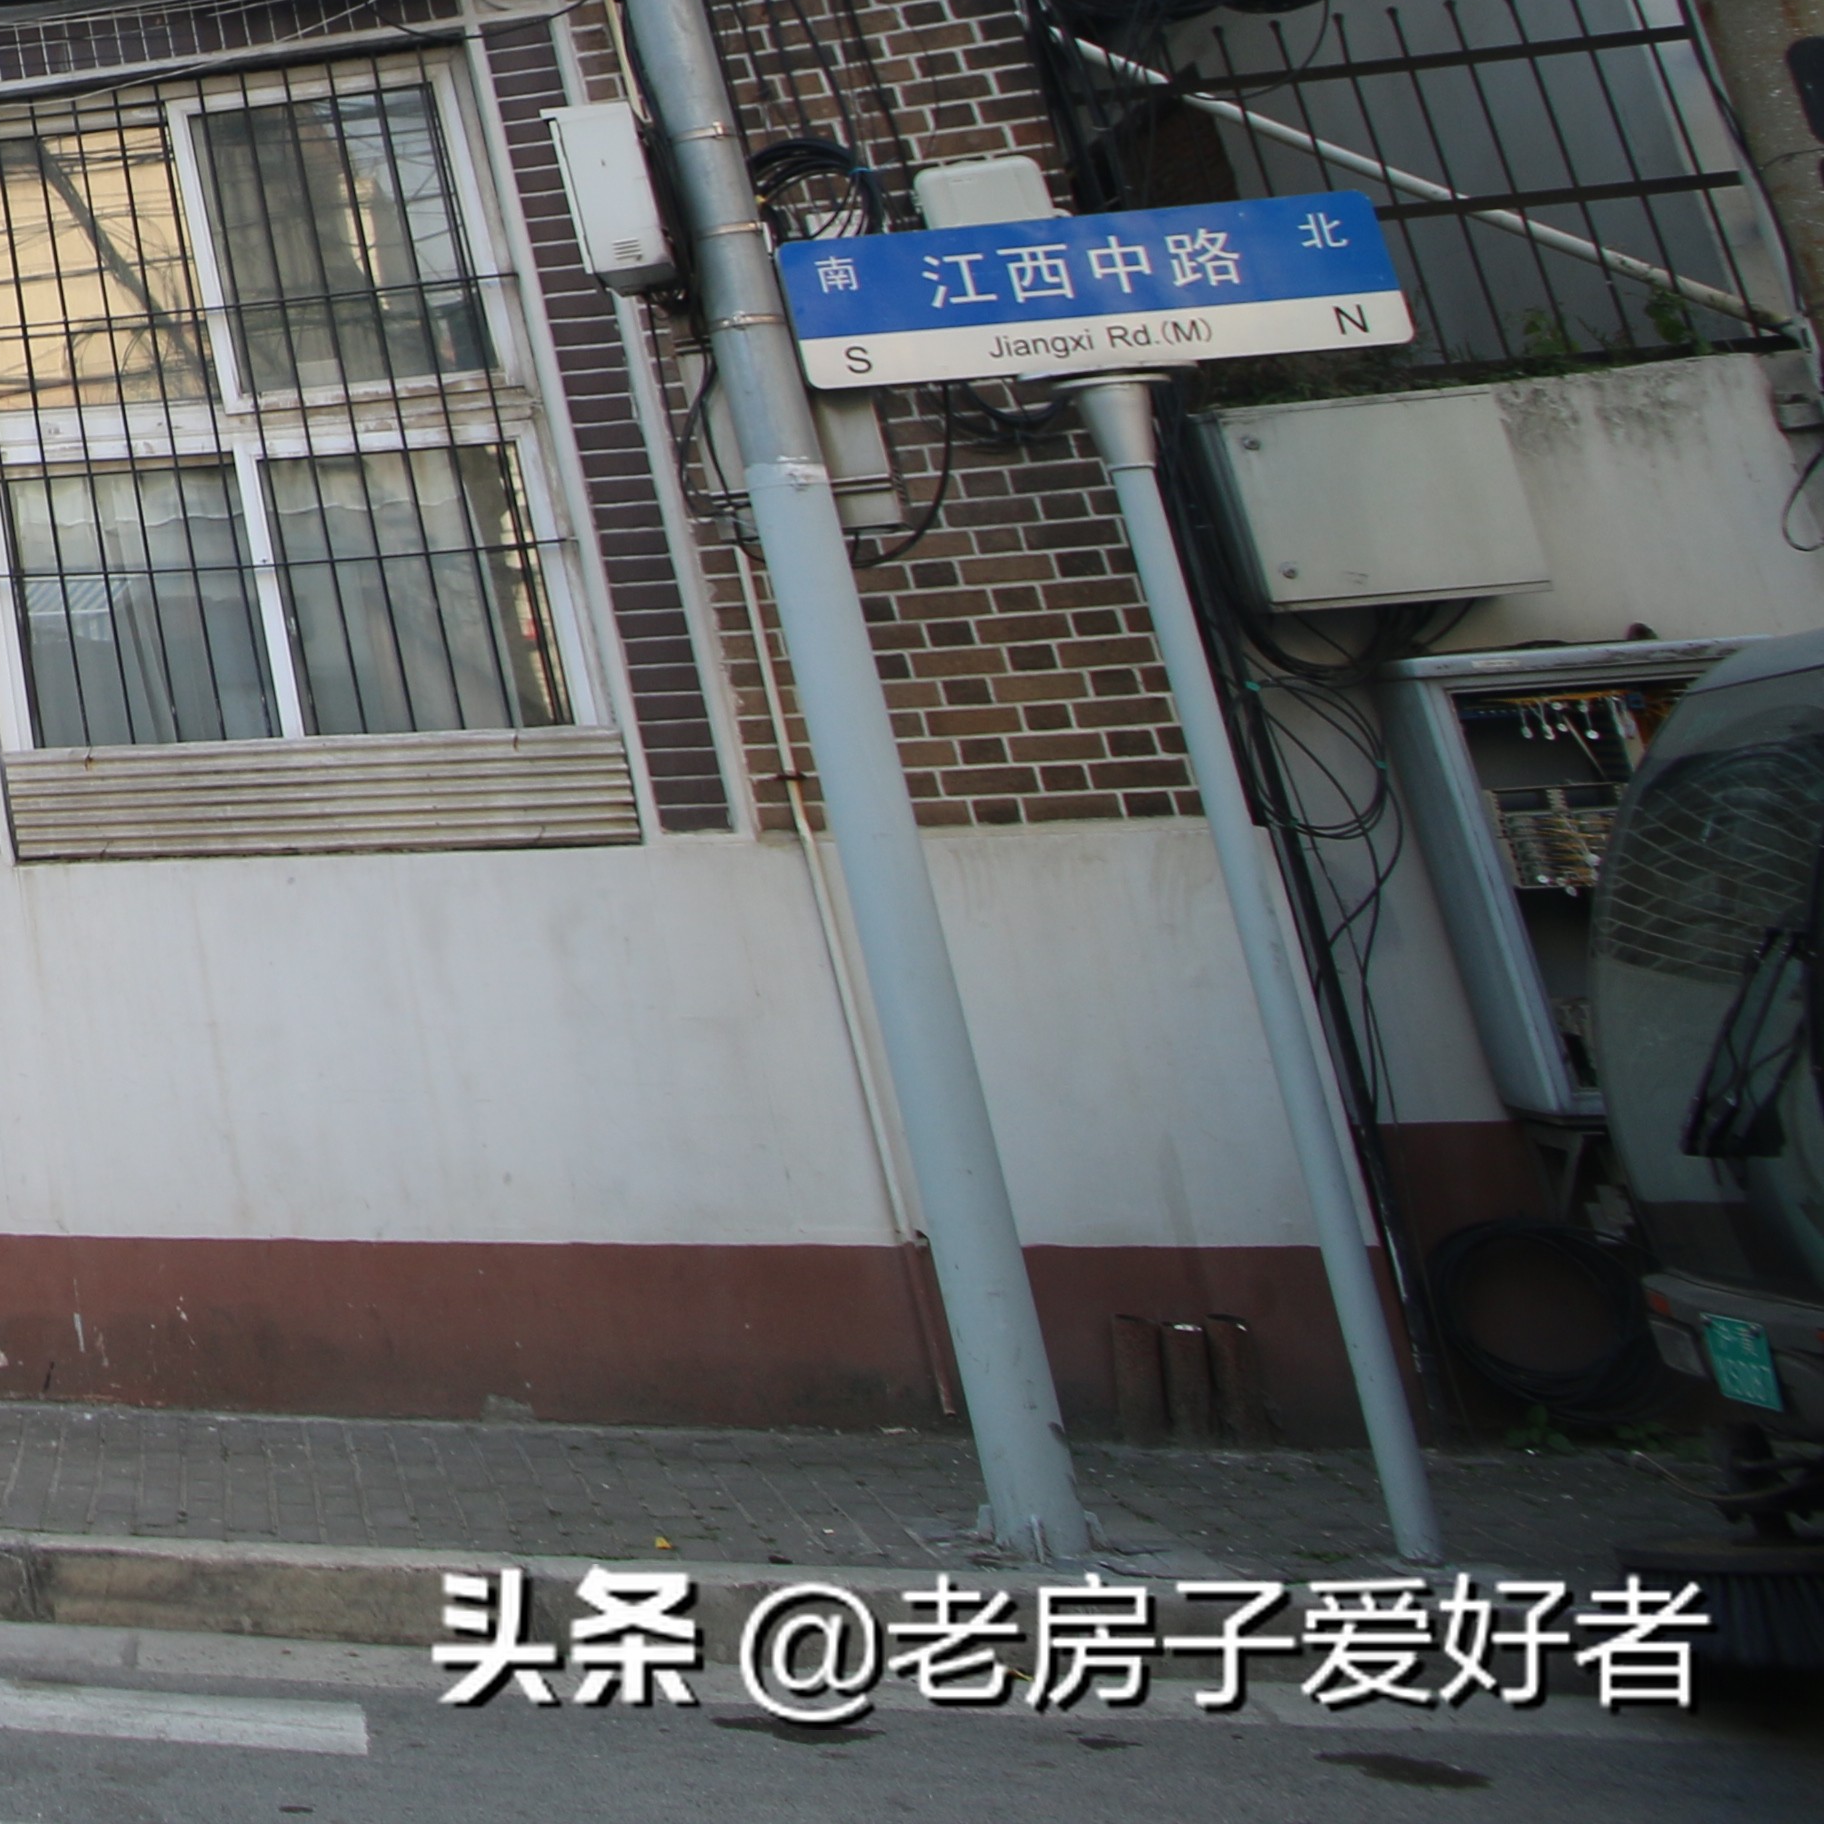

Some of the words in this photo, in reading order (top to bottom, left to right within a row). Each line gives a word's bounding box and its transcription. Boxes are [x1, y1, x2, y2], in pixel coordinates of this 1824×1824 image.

[814, 255, 860, 294] 南
[922, 227, 1242, 309] 江西中路
[1298, 212, 1350, 250] 北
[844, 346, 874, 375] S
[989, 327, 1094, 360] Jiangxi
[1107, 317, 1213, 349] Rd.(M)
[1332, 304, 1370, 336] N
